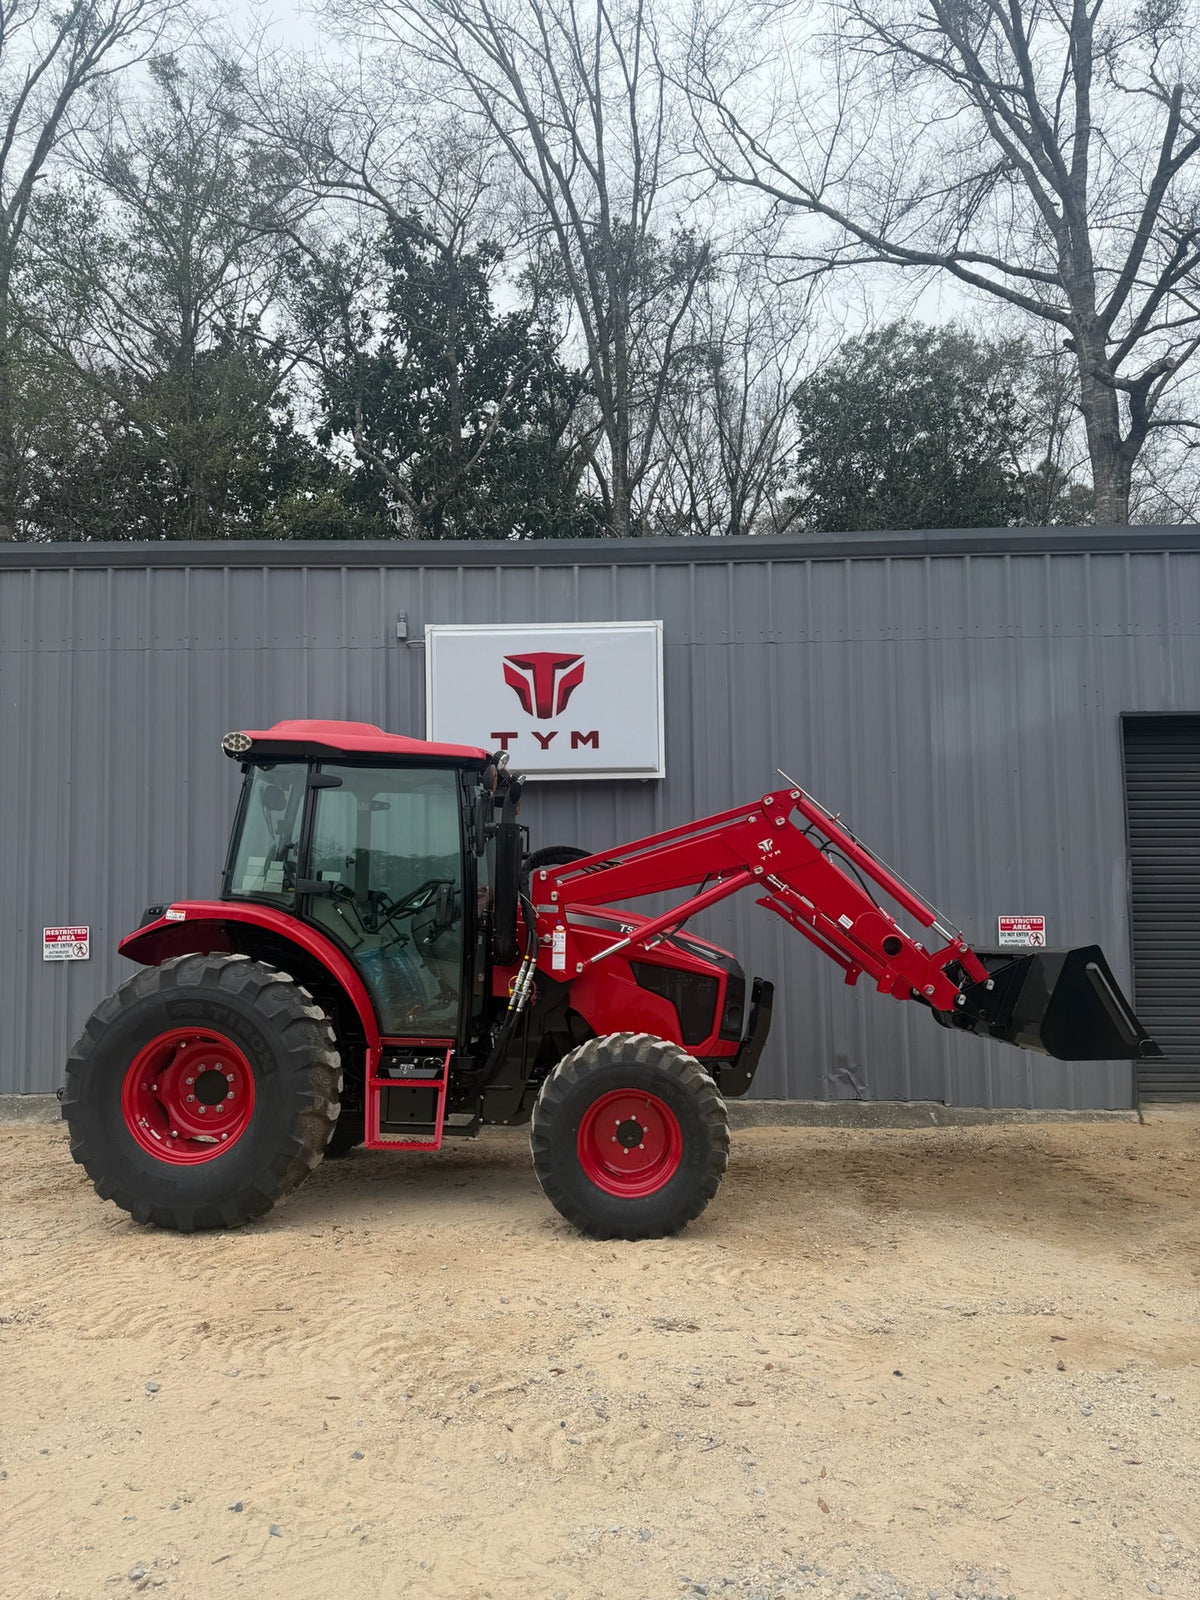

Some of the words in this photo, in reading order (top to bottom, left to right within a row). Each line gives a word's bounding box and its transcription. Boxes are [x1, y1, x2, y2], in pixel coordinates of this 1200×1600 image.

[490, 730, 599, 750] TYM
[760, 849, 781, 861] TYM
[45, 928, 87, 936] RESTRICTED
[620, 923, 638, 934] T5
